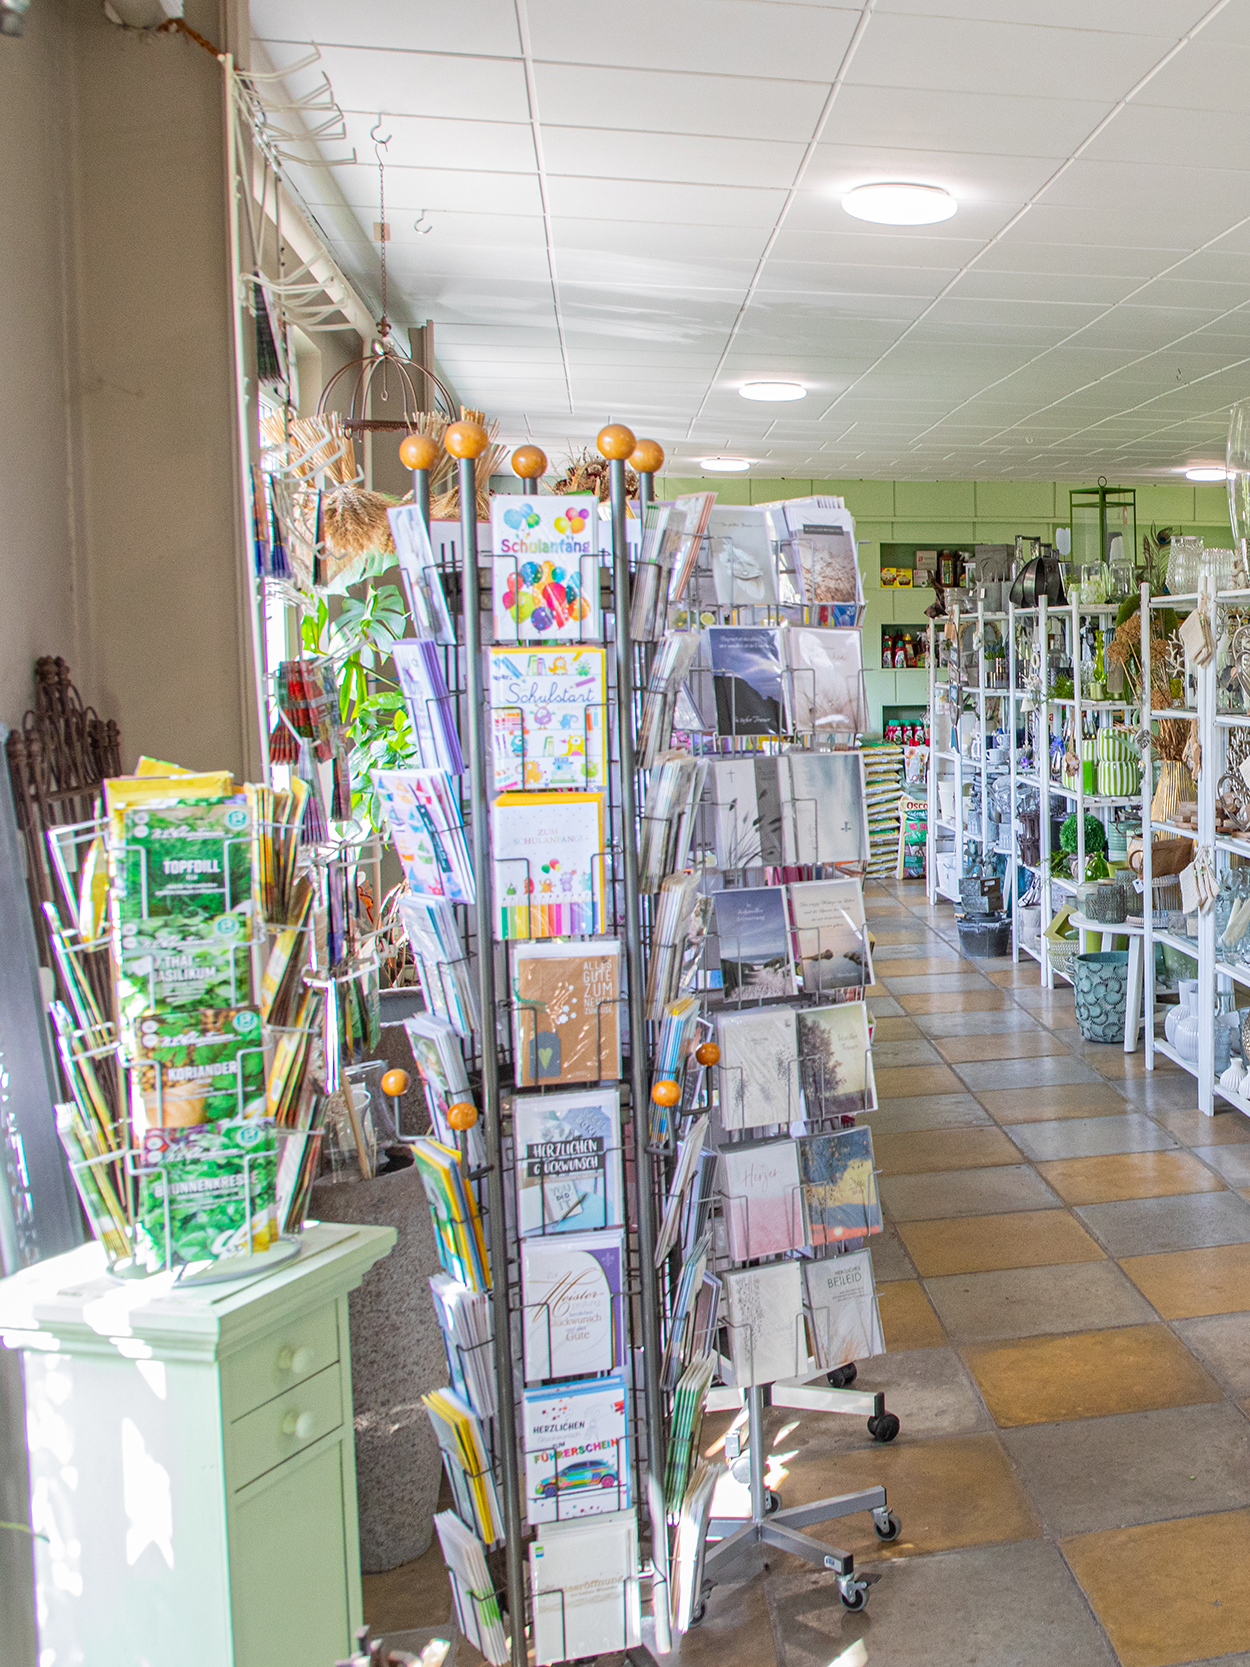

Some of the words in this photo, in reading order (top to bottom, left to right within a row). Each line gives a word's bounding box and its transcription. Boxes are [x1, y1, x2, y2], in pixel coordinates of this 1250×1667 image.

[501, 539, 590, 554] Schulanfang
[506, 682, 594, 703] Schulstart
[538, 828, 558, 836] ZUM
[162, 859, 221, 875] TOPFDILL
[584, 959, 612, 970] ALLES
[583, 970, 612, 983] GUTE
[584, 982, 613, 998] ZUM
[168, 1060, 238, 1081] KORIANDER
[533, 1139, 598, 1158] HERZLICHEN
[534, 1156, 599, 1175] GÜCKWUNSCH
[155, 1171, 259, 1198] BUNNENKRESE
[827, 1272, 862, 1289] BEILEID
[551, 1313, 602, 1328] lückwunsch
[566, 1331, 590, 1342] Gute
[533, 1421, 586, 1434] HERZLICHEN
